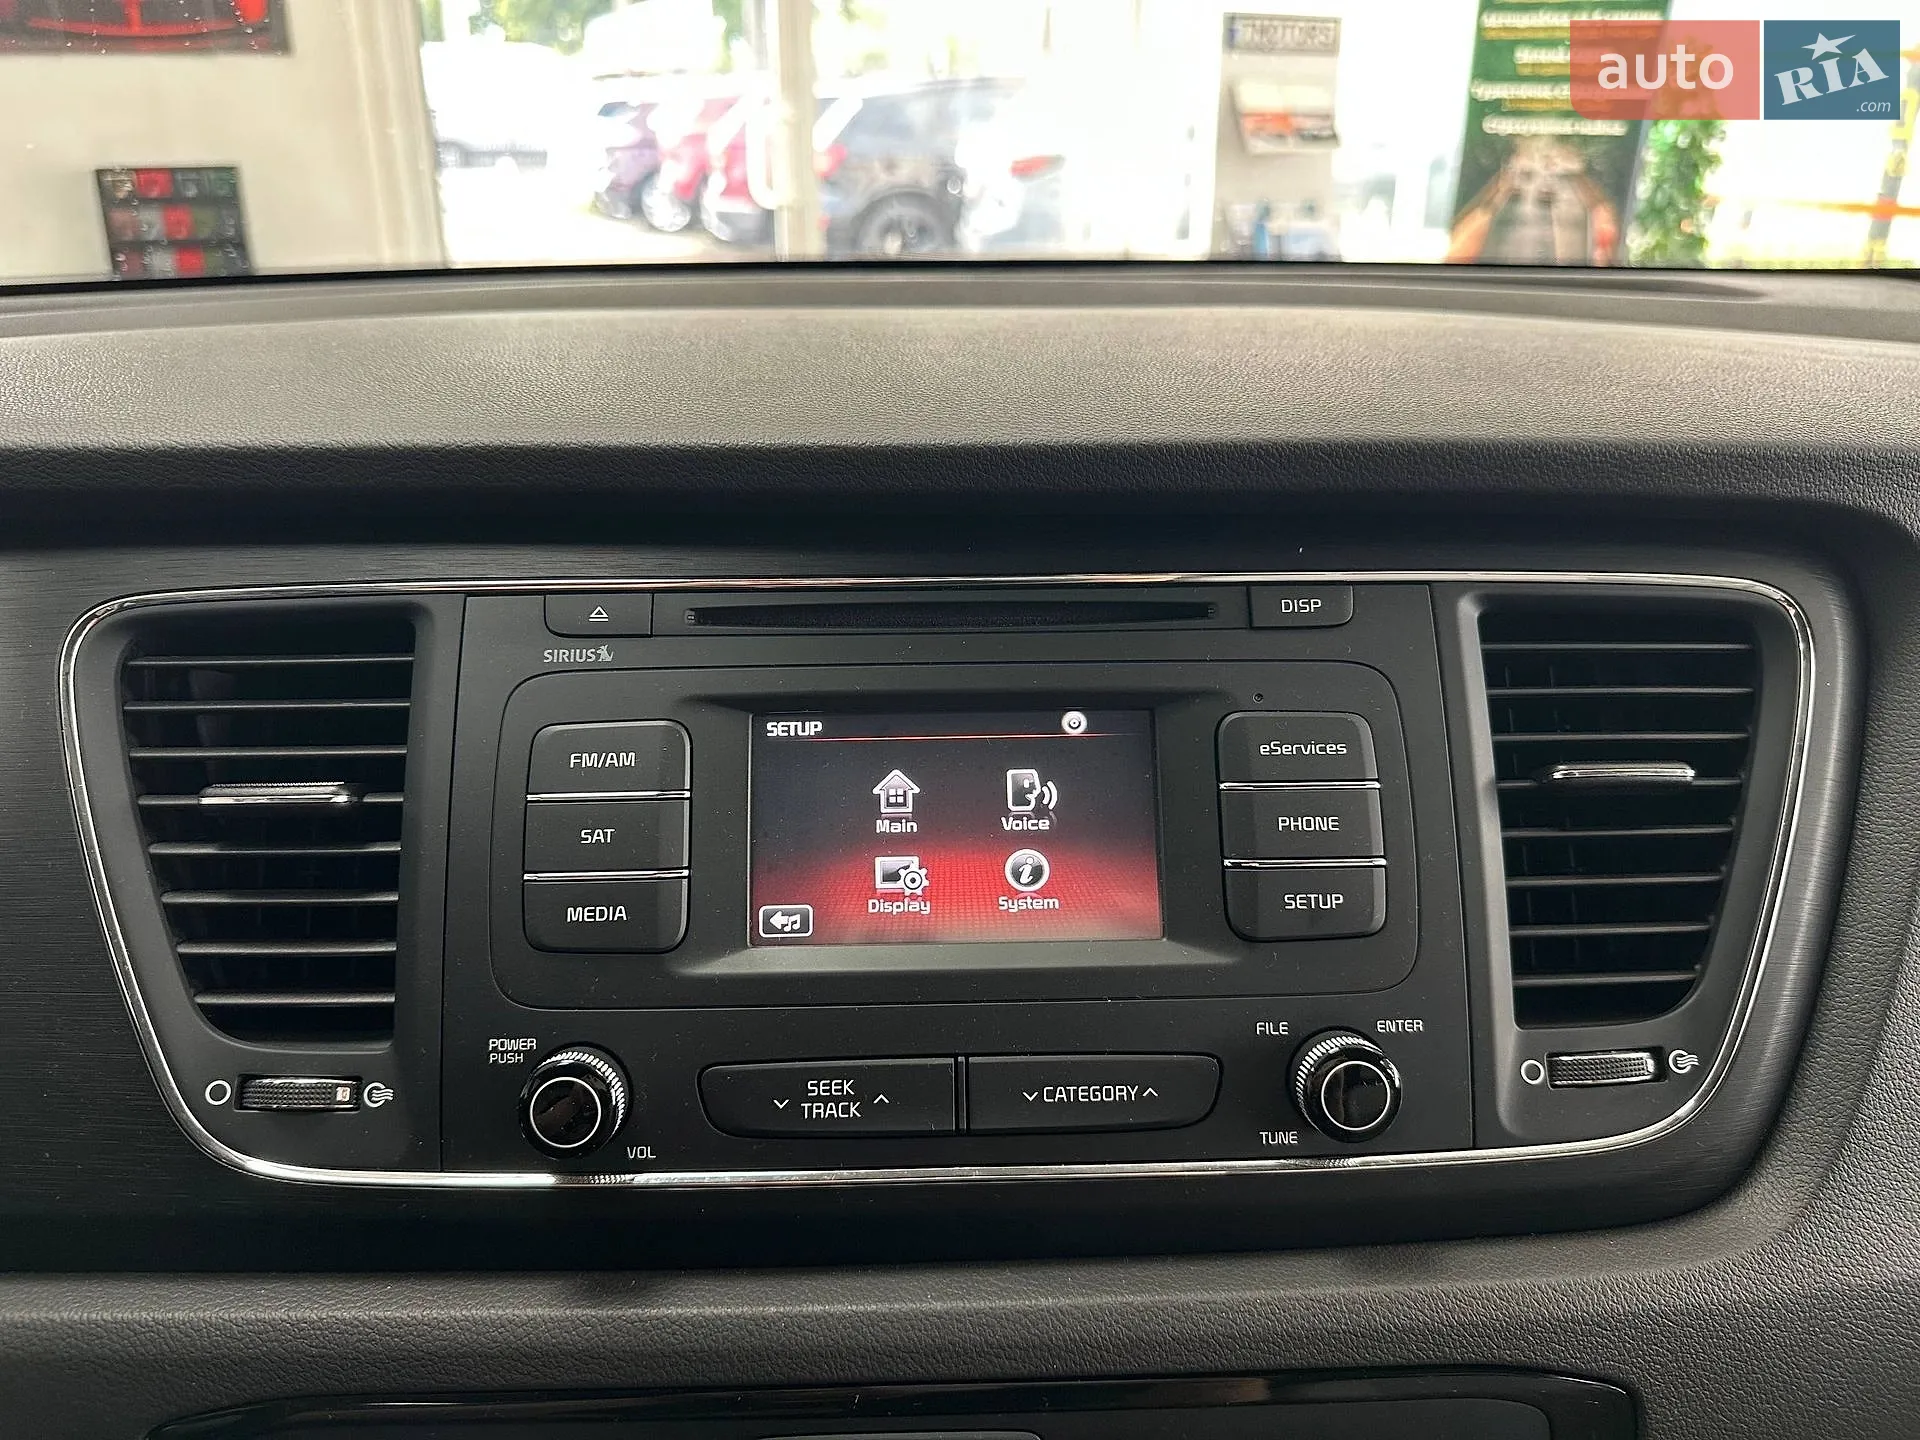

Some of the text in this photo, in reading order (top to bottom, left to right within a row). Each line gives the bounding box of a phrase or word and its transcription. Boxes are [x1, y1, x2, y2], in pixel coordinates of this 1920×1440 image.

[1281, 598, 1322, 613] DISP
[543, 648, 597, 663] SIRIUS
[766, 720, 823, 737] SETUP
[1259, 740, 1348, 756] eServices
[569, 751, 638, 769] FM/AM
[875, 819, 918, 834] Main
[1000, 815, 1050, 831] Voice
[1278, 816, 1340, 832] PHONE
[580, 828, 616, 844] SAT
[867, 897, 931, 915] Display
[998, 896, 1060, 912] System
[1284, 893, 1344, 910] SETUP
[566, 905, 627, 923] MEDIA
[1256, 1021, 1289, 1035] FILE
[1376, 1019, 1424, 1033] ENTER
[488, 1037, 537, 1051] POWER
[489, 1052, 524, 1064] PUSH
[807, 1079, 855, 1096] SEEK
[1043, 1085, 1139, 1103] CATEGORY
[800, 1101, 862, 1119] TRACK
[1259, 1131, 1298, 1145] TUNE
[626, 1146, 657, 1159] VOL
